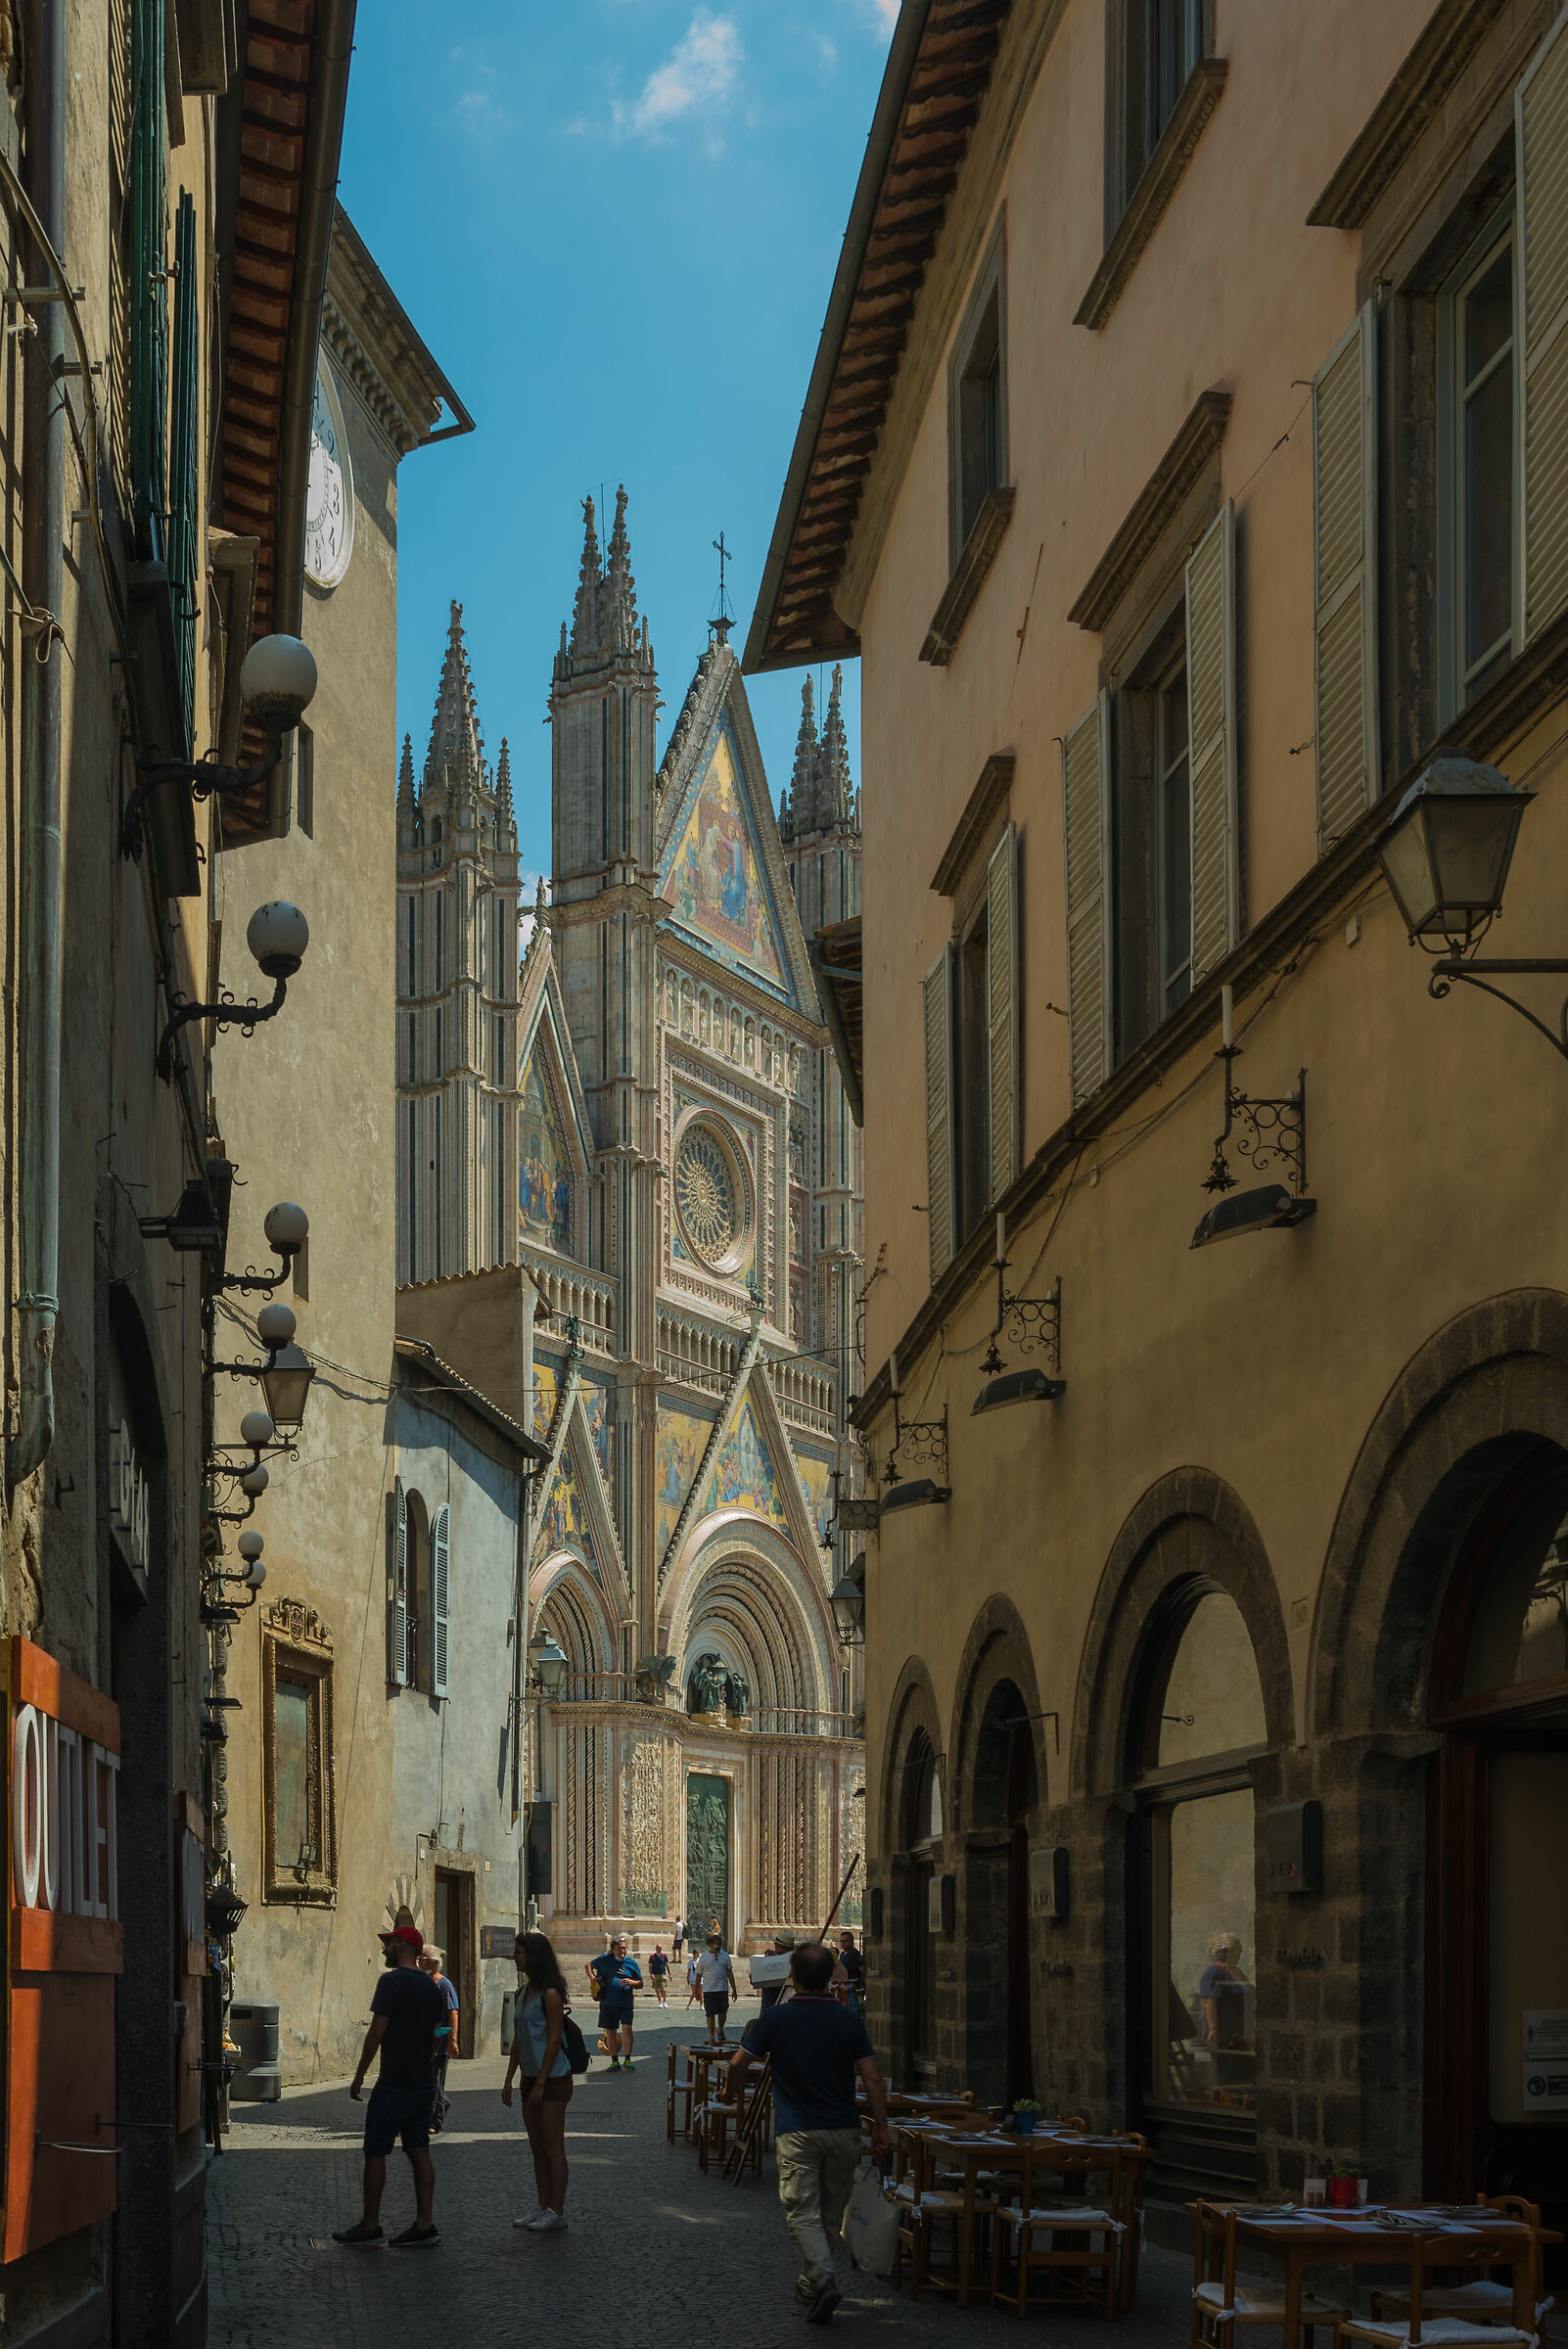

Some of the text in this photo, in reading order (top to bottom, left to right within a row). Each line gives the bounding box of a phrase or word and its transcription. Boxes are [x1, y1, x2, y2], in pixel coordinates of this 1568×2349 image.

[332, 483, 341, 516] 3
[314, 538, 323, 572] 5
[327, 525, 336, 558] 4
[118, 1417, 151, 1578] G148
[14, 1702, 121, 1922] OUTLET
